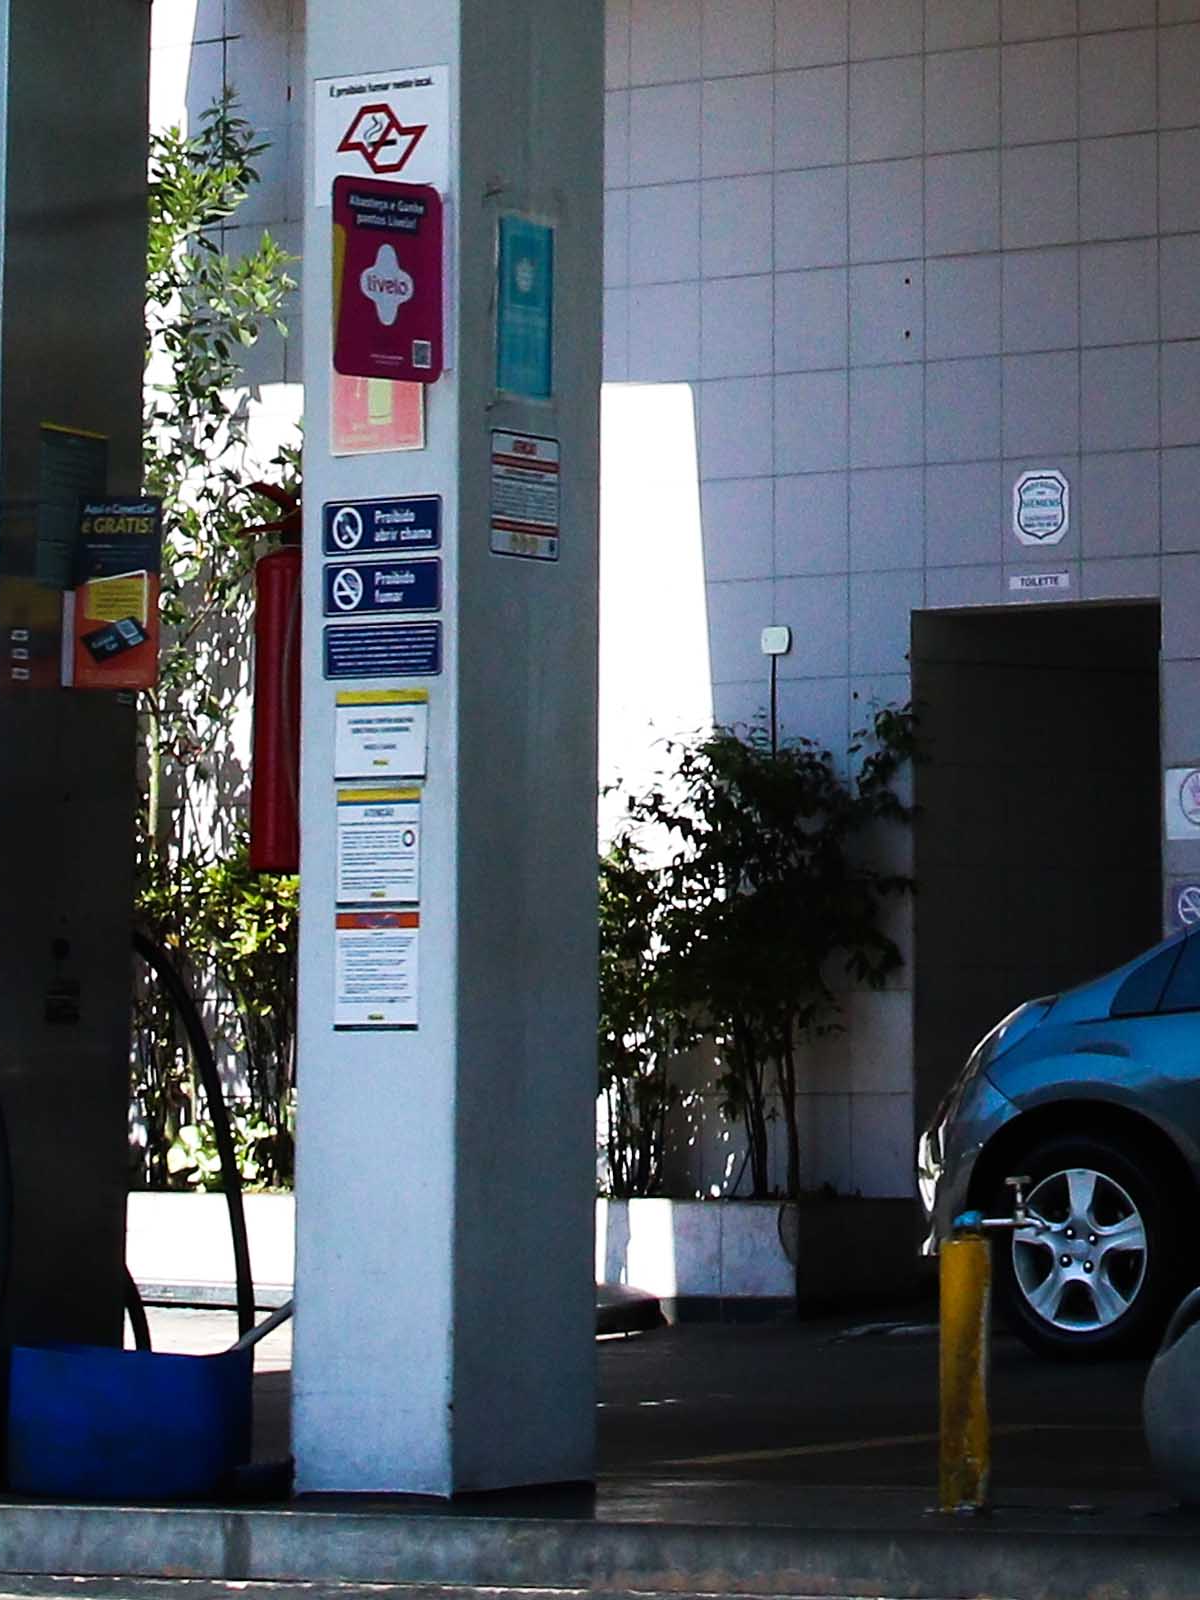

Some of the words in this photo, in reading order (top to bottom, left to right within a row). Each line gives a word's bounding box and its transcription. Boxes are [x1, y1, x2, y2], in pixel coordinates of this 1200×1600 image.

[366, 272, 409, 295] livelo
[374, 509, 416, 524] Proibido
[374, 528, 398, 543] abrir
[400, 526, 433, 541] chama
[374, 570, 416, 586] Proibido
[1020, 576, 1059, 588] TOILETTE
[374, 589, 404, 604] fumar
